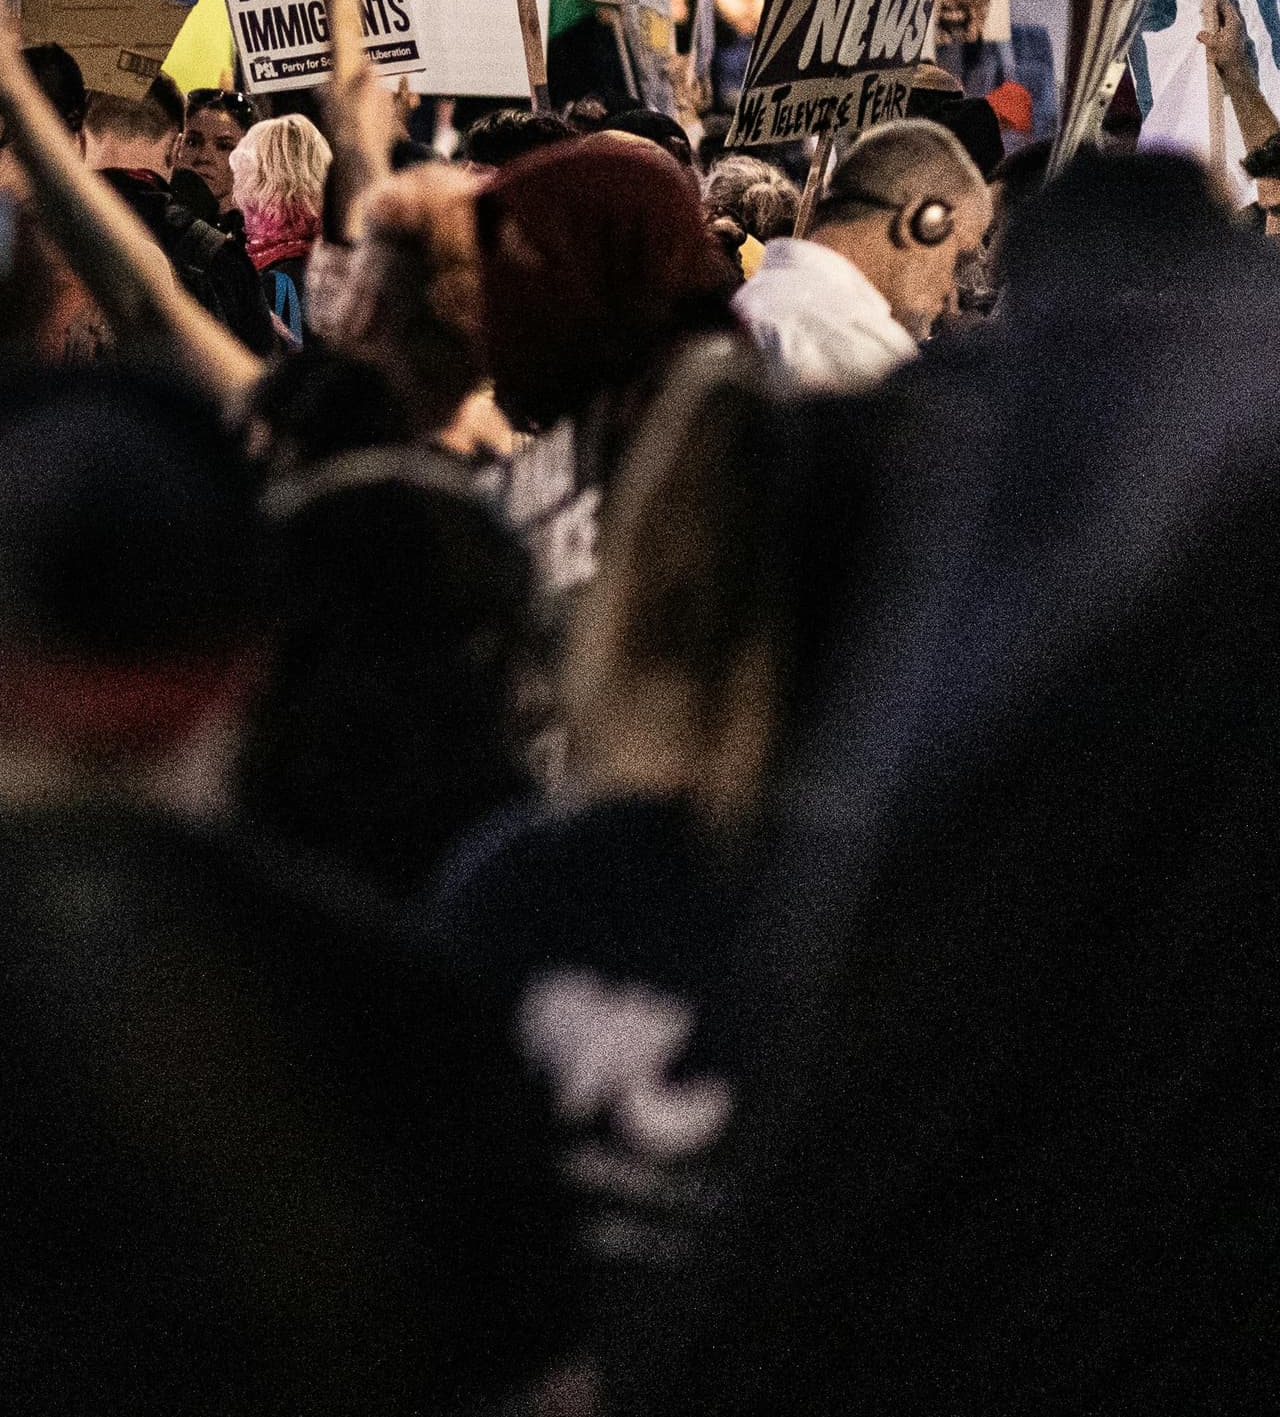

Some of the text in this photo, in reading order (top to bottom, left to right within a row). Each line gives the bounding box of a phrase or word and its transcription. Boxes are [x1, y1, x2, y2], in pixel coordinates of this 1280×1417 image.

[254, 60, 279, 81] PSL
[282, 57, 305, 74] Party
[306, 56, 320, 70] for
[371, 46, 412, 62] Liberation
[857, 73, 906, 128] FEAR
